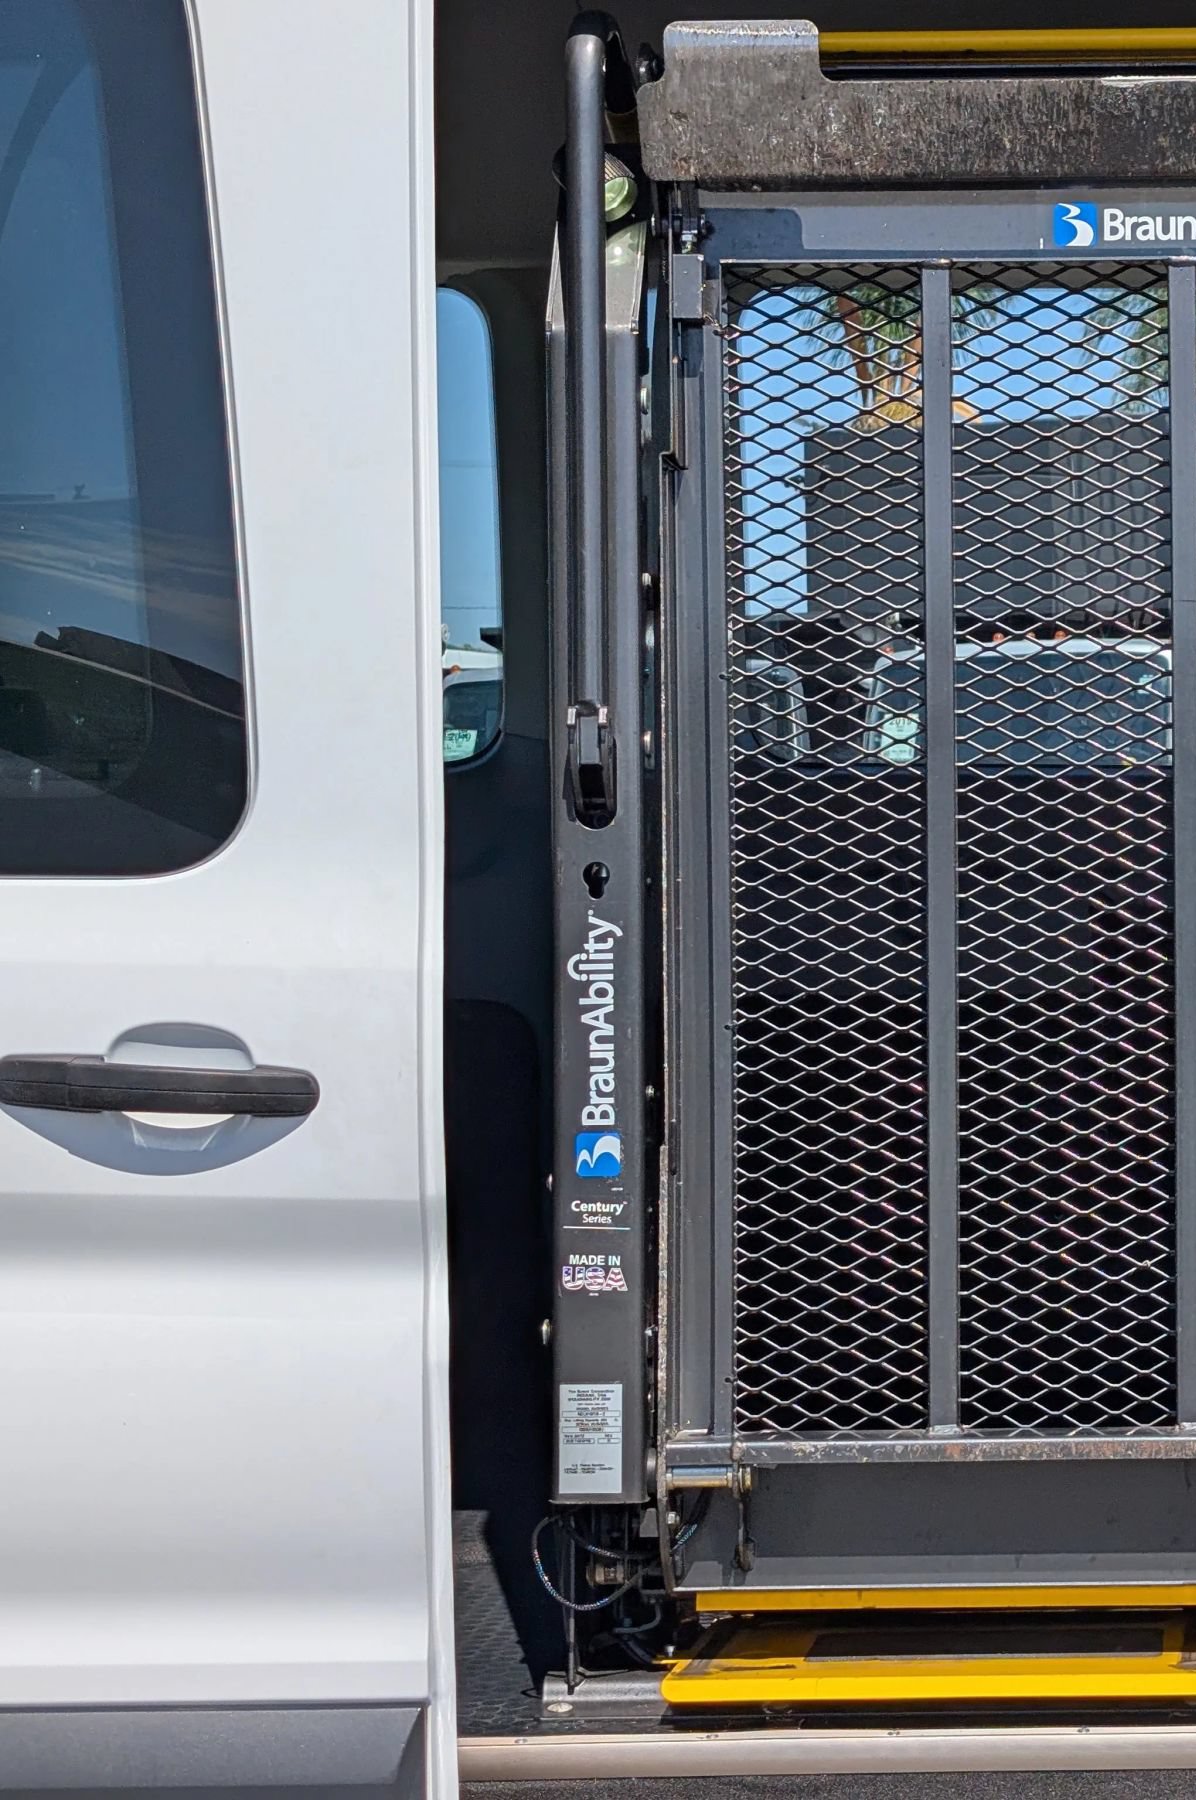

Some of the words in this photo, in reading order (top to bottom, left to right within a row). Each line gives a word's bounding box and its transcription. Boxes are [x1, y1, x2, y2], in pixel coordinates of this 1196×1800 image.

[567, 909, 623, 1126] BraunAbility
[571, 1200, 625, 1215] Century
[582, 1213, 612, 1224] Series
[569, 1254, 606, 1266] MADE
[608, 1255, 621, 1266] IN
[562, 1266, 628, 1292] USA
